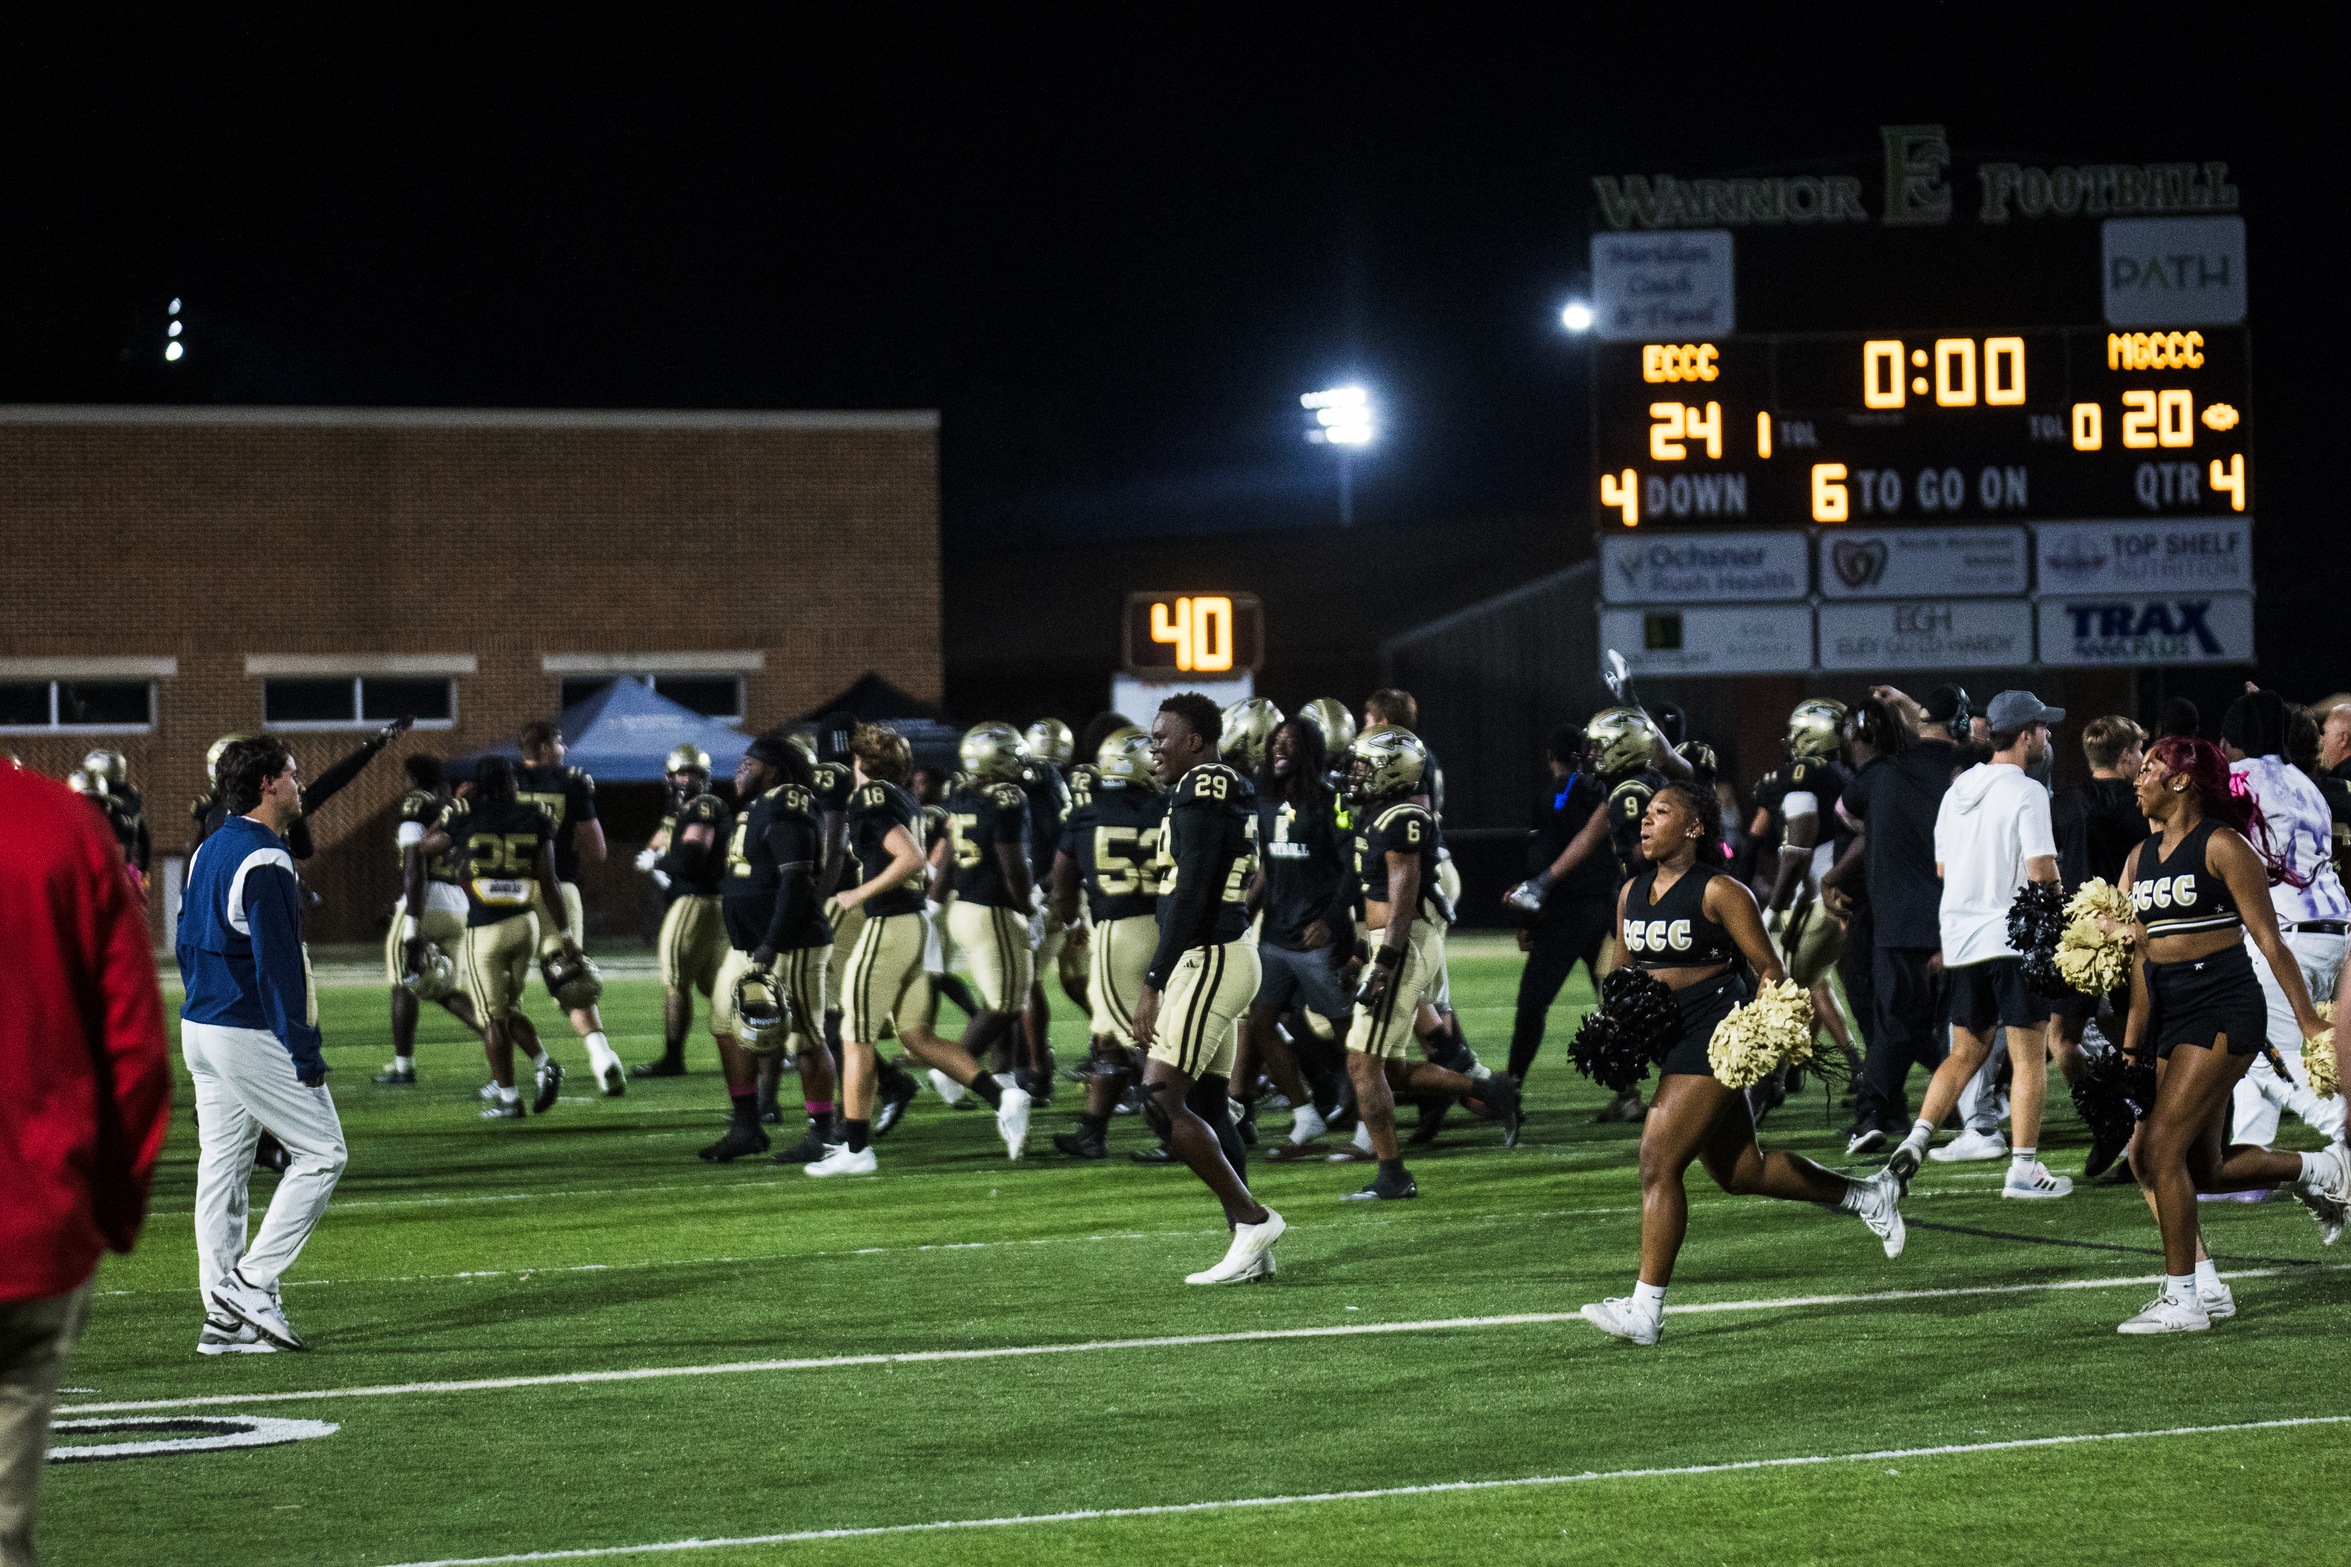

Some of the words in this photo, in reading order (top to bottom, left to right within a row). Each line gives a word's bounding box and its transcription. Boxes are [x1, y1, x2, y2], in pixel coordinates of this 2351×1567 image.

[2112, 256, 2229, 290] PATH
[1643, 344, 1719, 383] ECCC
[1864, 337, 2025, 409] 0:00
[2108, 331, 2204, 370] MGCCC
[1650, 401, 1722, 460] 24
[1758, 411, 1771, 458] 1
[2072, 403, 2102, 451] 0
[2122, 390, 2193, 448] 20
[1601, 469, 1638, 526] 4
[1645, 473, 1747, 517] DOWN
[1812, 463, 1848, 522] 6
[1856, 468, 1901, 512] TO
[1916, 466, 1964, 510] GO
[1979, 465, 2027, 509] ON
[2134, 462, 2201, 509] QTR
[2210, 454, 2245, 511] 4
[1648, 545, 1766, 567] Ochsner
[2112, 535, 2158, 555] TOP
[2165, 533, 2240, 554] SHELF
[1151, 596, 1233, 672] 40
[2065, 600, 2222, 655] TRAX
[862, 786, 887, 808] 18
[1195, 773, 1228, 799] 29
[1623, 795, 1640, 819] 9
[949, 812, 983, 868] 5
[1407, 819, 1421, 845] 6
